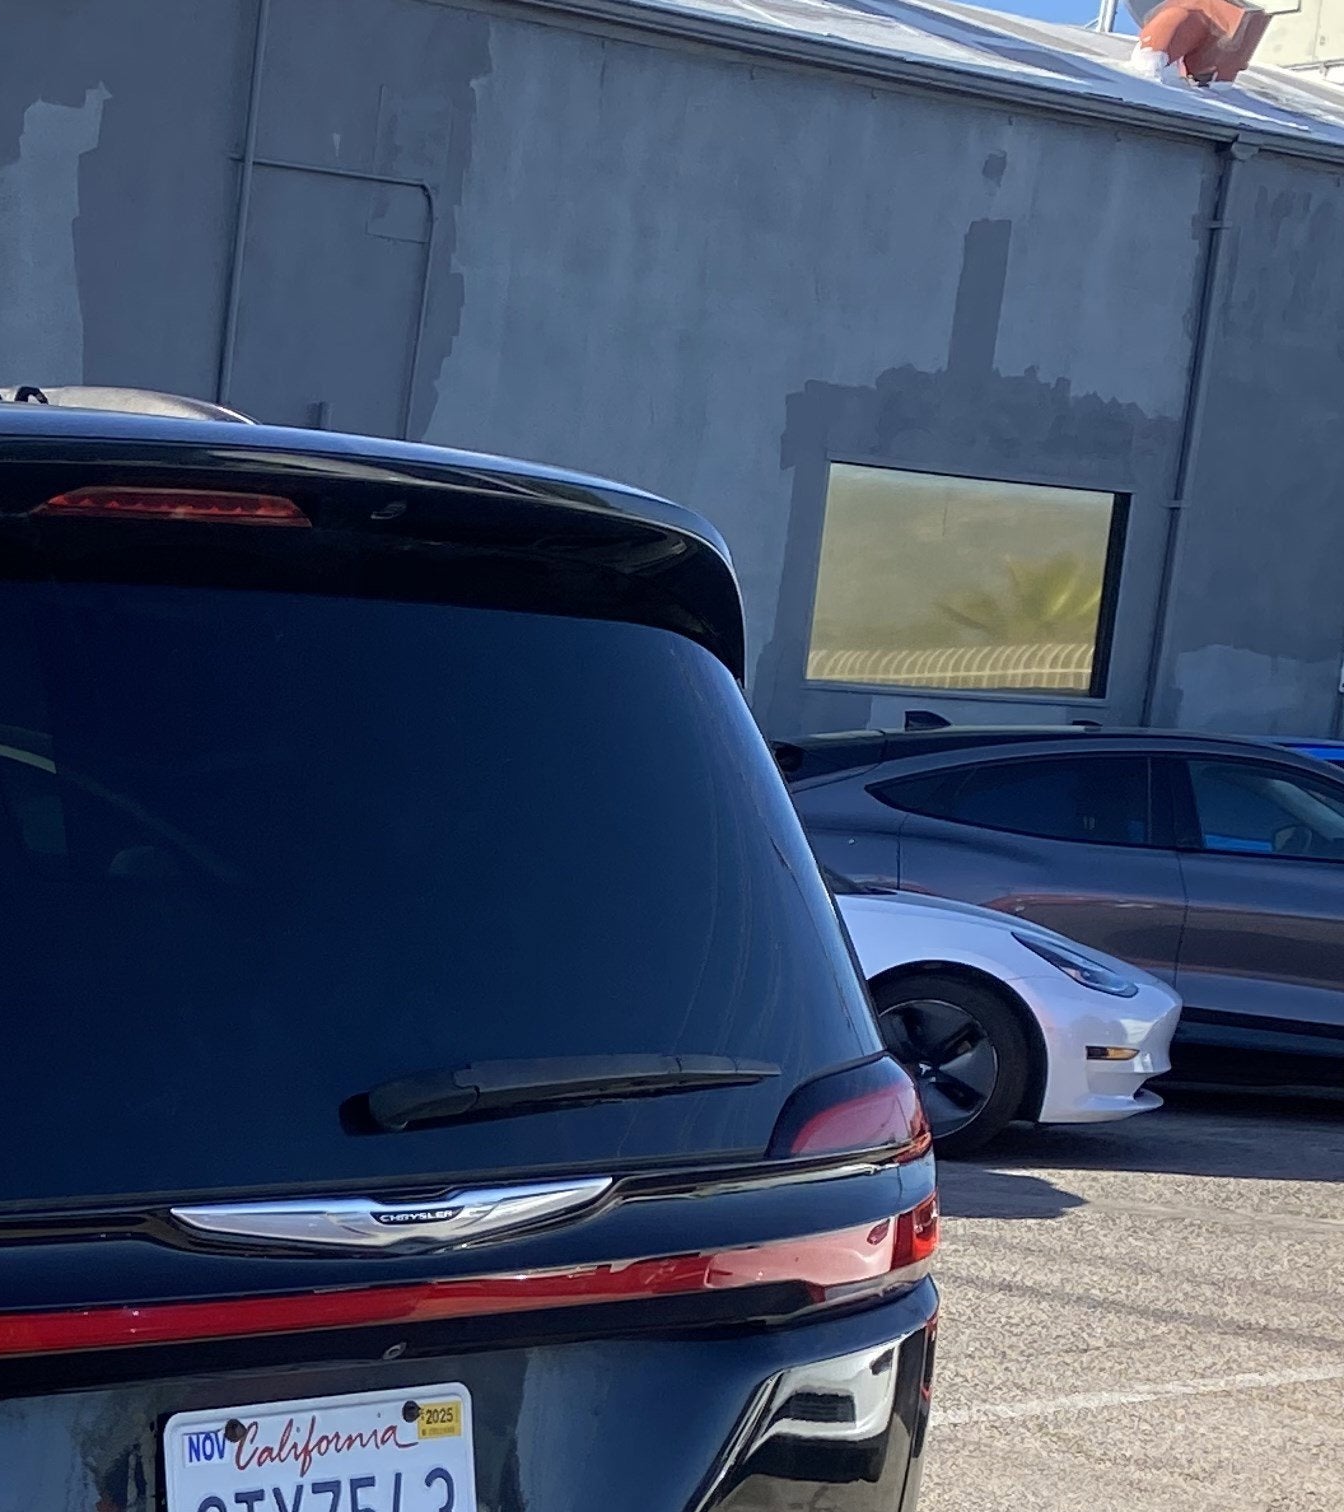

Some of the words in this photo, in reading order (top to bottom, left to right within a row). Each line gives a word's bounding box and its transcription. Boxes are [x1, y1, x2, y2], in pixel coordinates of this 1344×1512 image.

[379, 1208, 454, 1223] CHRYSLER
[425, 1406, 454, 1426] 2025
[188, 1430, 227, 1464] NOV
[235, 1415, 419, 1478] California
